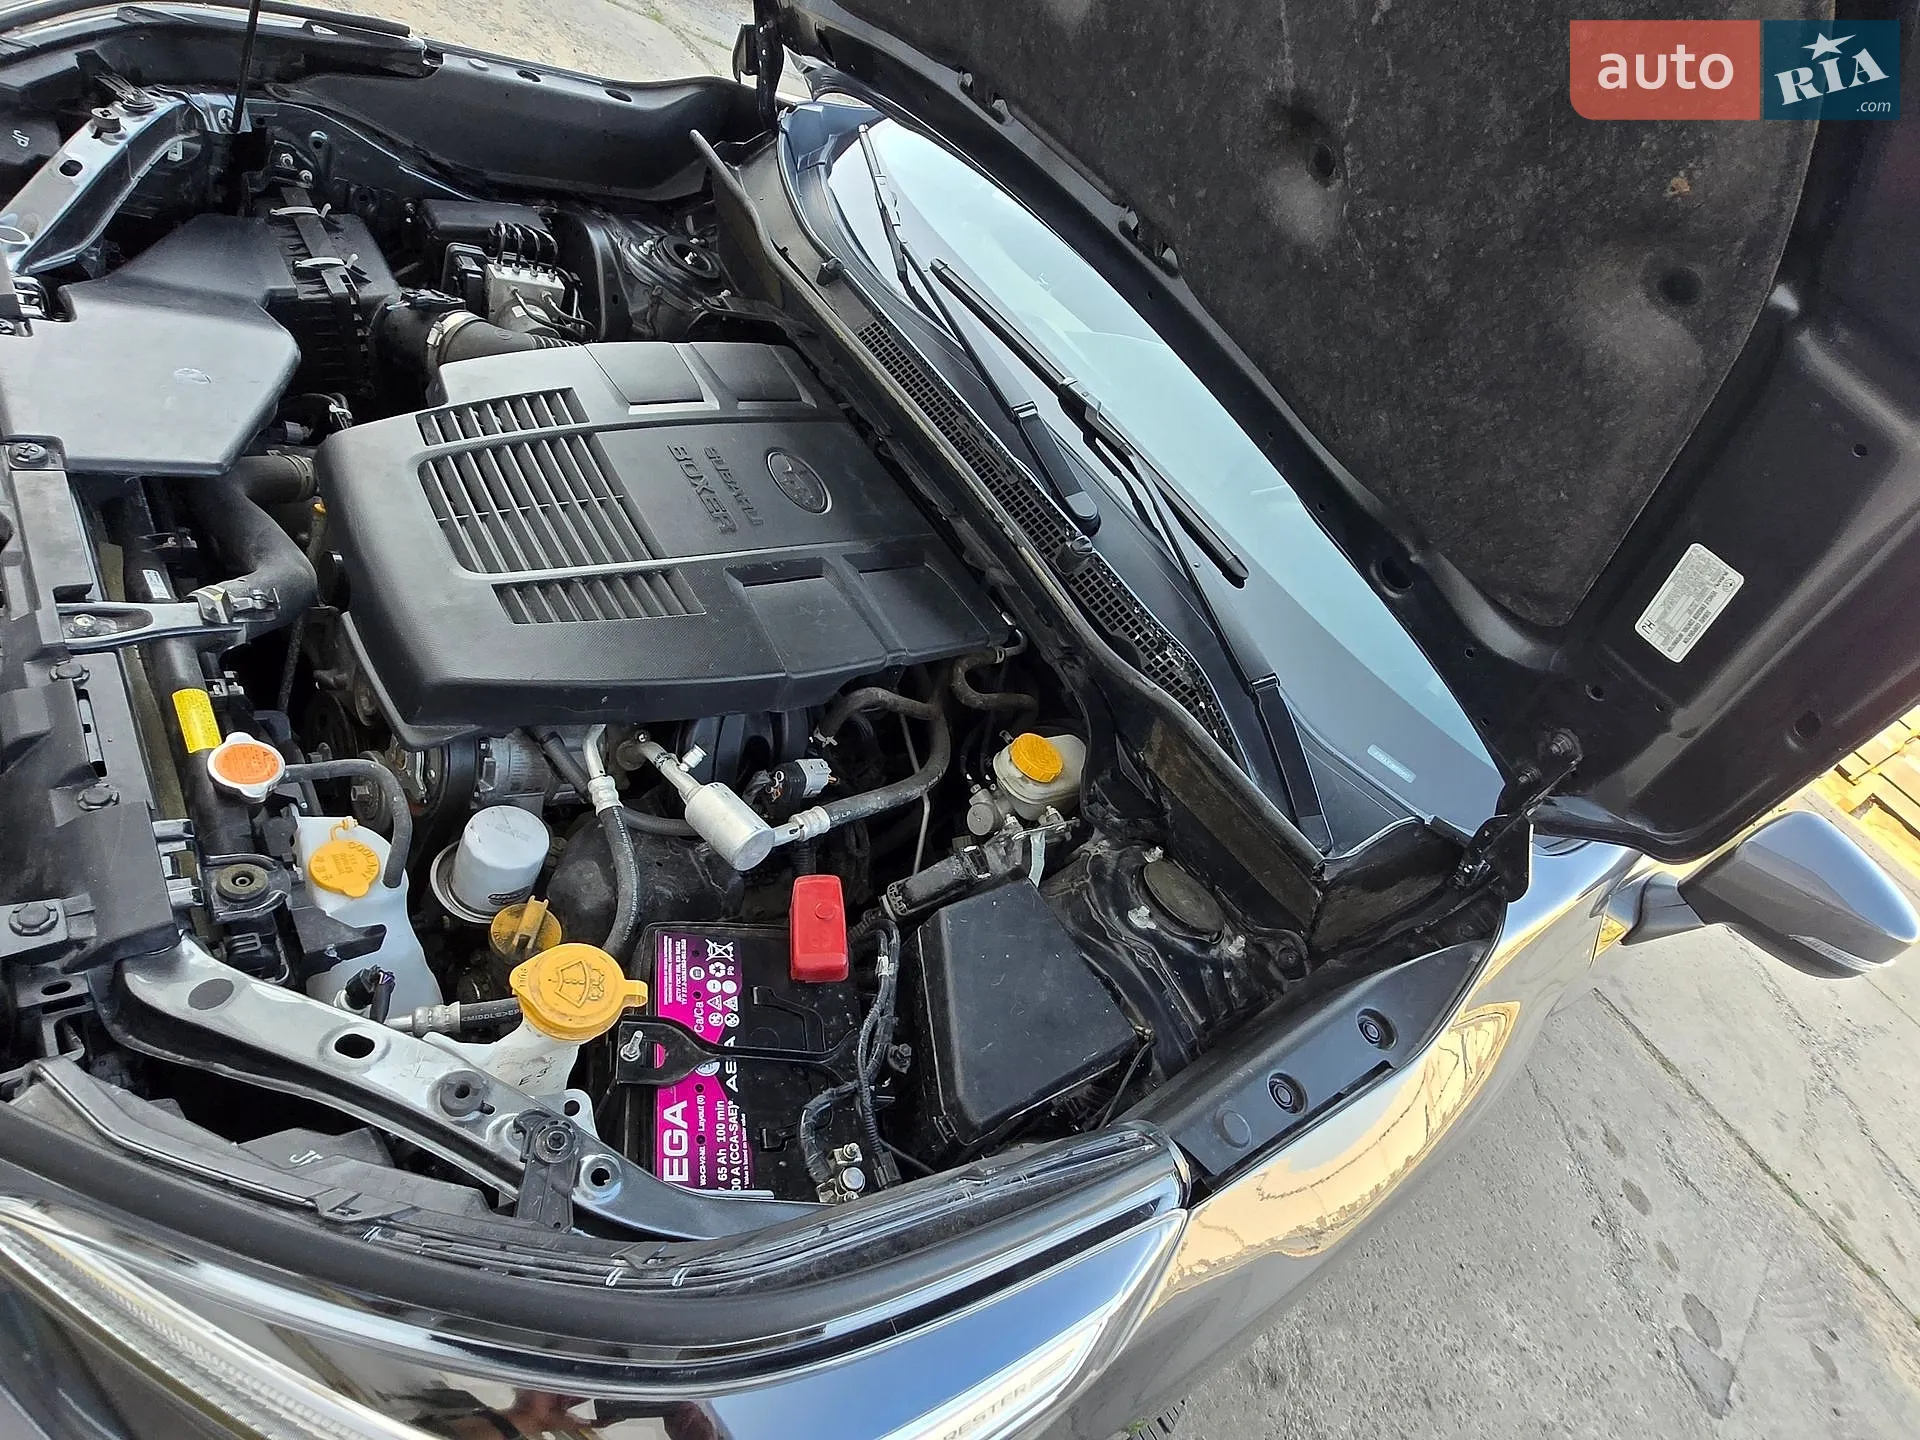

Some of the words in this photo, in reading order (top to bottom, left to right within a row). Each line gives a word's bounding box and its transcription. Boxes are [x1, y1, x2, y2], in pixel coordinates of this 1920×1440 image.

[666, 443, 738, 535] BOXER
[703, 446, 764, 528] SUBARU
[694, 1001, 705, 1033] Ca/Ca
[697, 1104, 706, 1132] Layout
[714, 1100, 725, 1120] min
[715, 1121, 726, 1143] 100
[716, 1148, 727, 1166] Ah
[717, 1166, 728, 1181] 65
[730, 1166, 741, 1176] A
